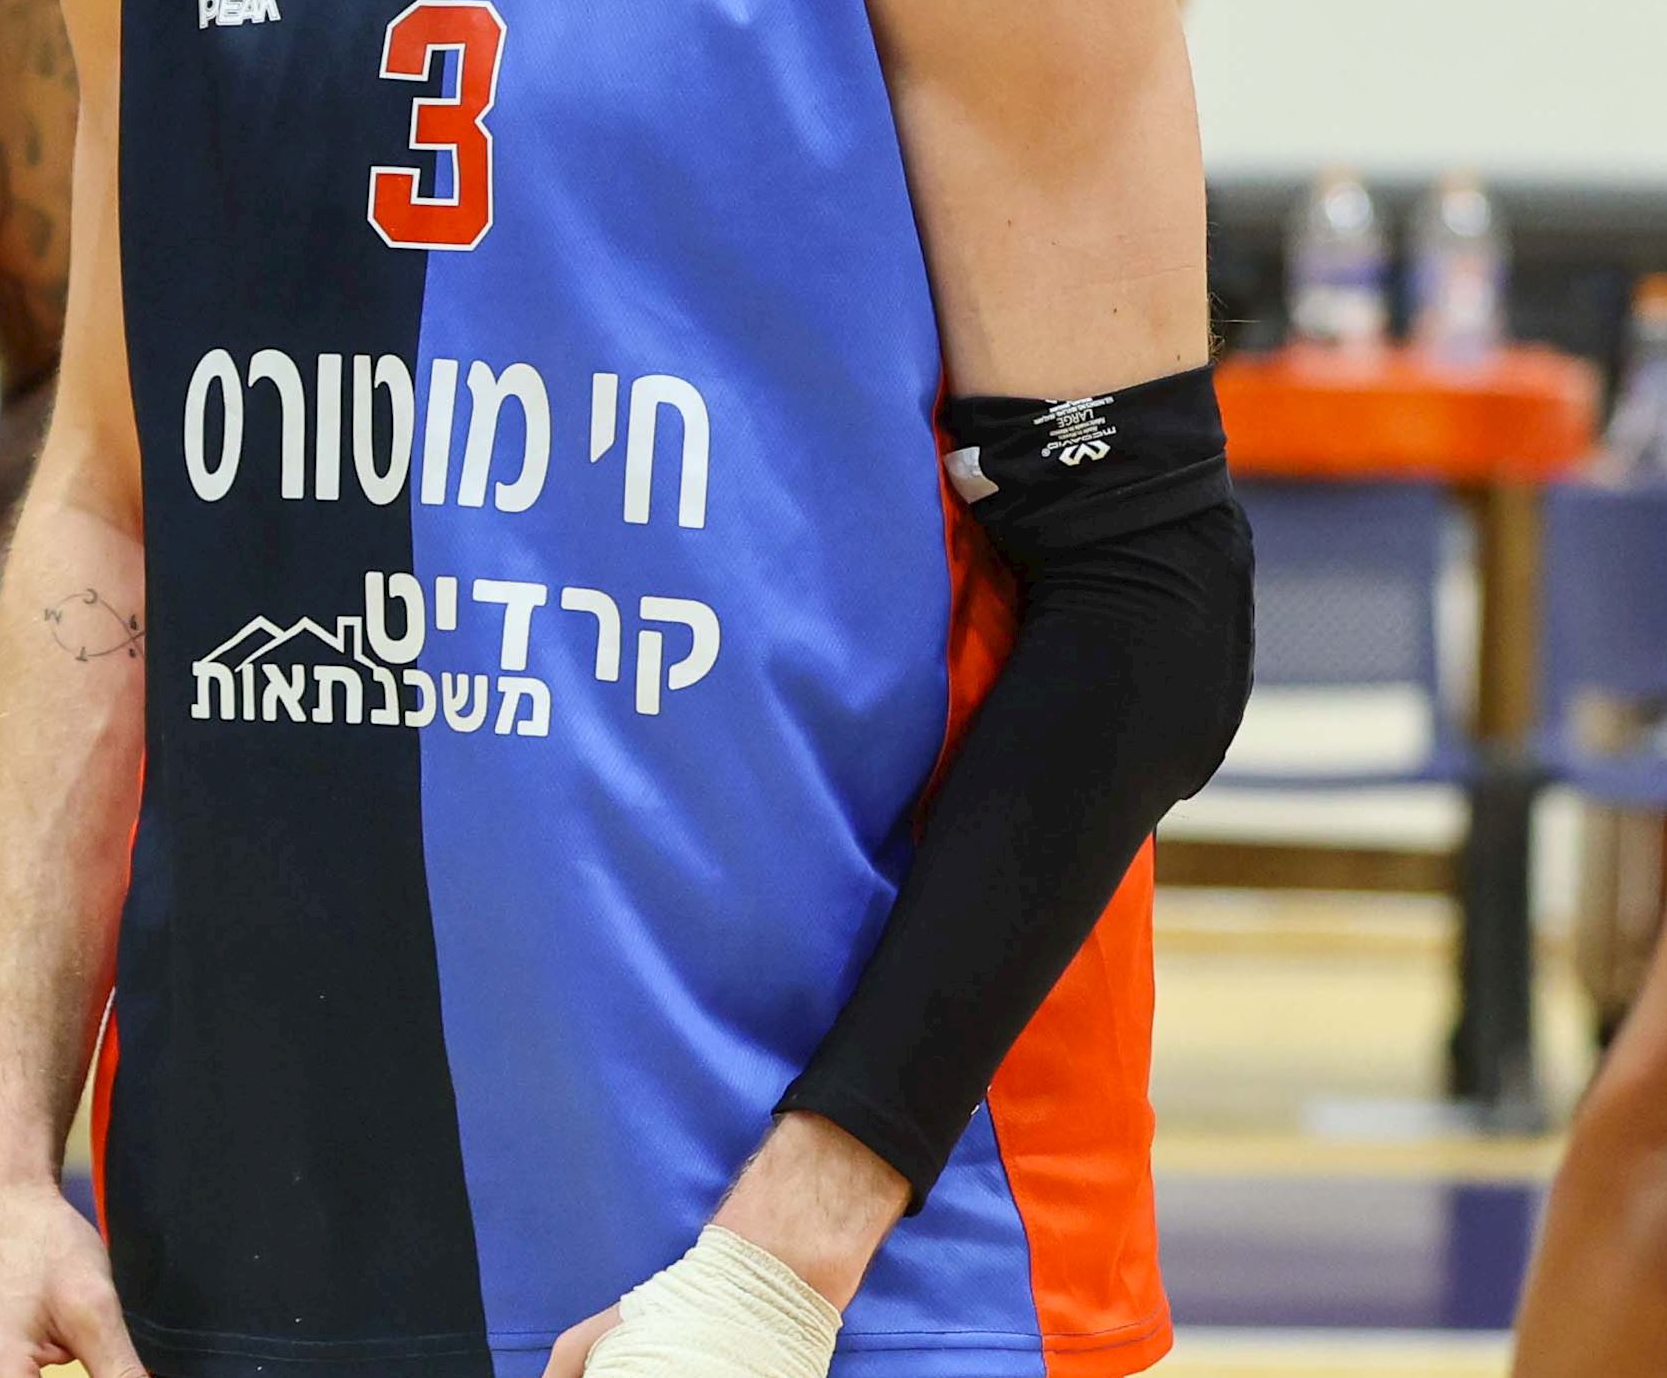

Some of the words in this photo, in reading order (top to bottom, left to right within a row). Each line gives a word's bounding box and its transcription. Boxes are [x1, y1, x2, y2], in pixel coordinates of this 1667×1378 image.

[368, 0, 507, 251] 3
[184, 348, 551, 512] מוטורס
[590, 372, 710, 529] חי
[1056, 408, 1094, 428] LARGE
[191, 660, 551, 738] משכנתאות
[365, 571, 721, 715] קרדיט
